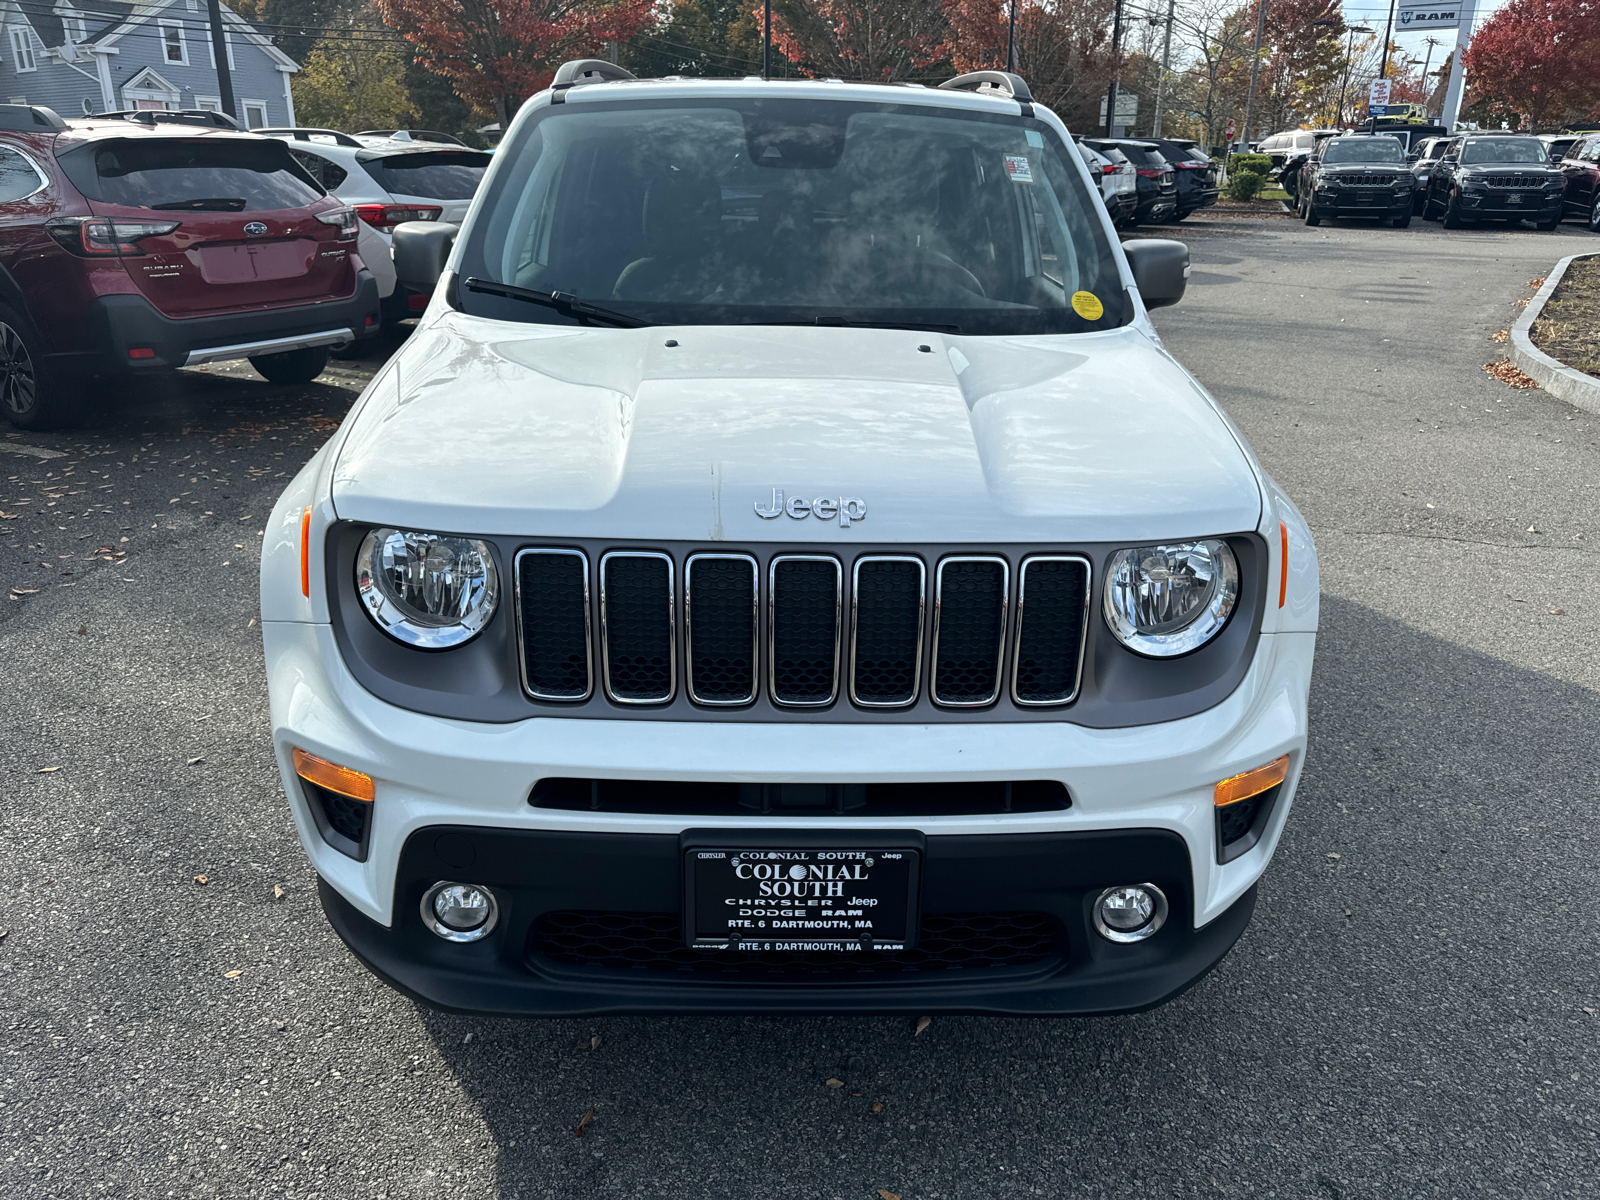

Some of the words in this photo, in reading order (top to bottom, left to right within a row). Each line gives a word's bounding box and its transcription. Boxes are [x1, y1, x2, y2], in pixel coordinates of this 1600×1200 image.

[1416, 12, 1455, 20] RAM
[754, 488, 867, 528] Jeep
[740, 852, 810, 860] COLONIAL
[817, 852, 866, 860] SOUTH
[882, 852, 902, 860] Jeep
[736, 863, 868, 880] COLONIAL
[759, 880, 844, 897] SOUTH
[847, 896, 878, 908] Jeep
[739, 908, 806, 916] DODGE
[728, 920, 755, 928] RTE.
[758, 920, 766, 928] 6
[772, 920, 852, 930] DARTMOUTH,
[738, 942, 762, 950] RTE.
[764, 942, 770, 950] 6
[776, 942, 844, 952] DARTMOUTH,
[846, 942, 862, 950] MA
